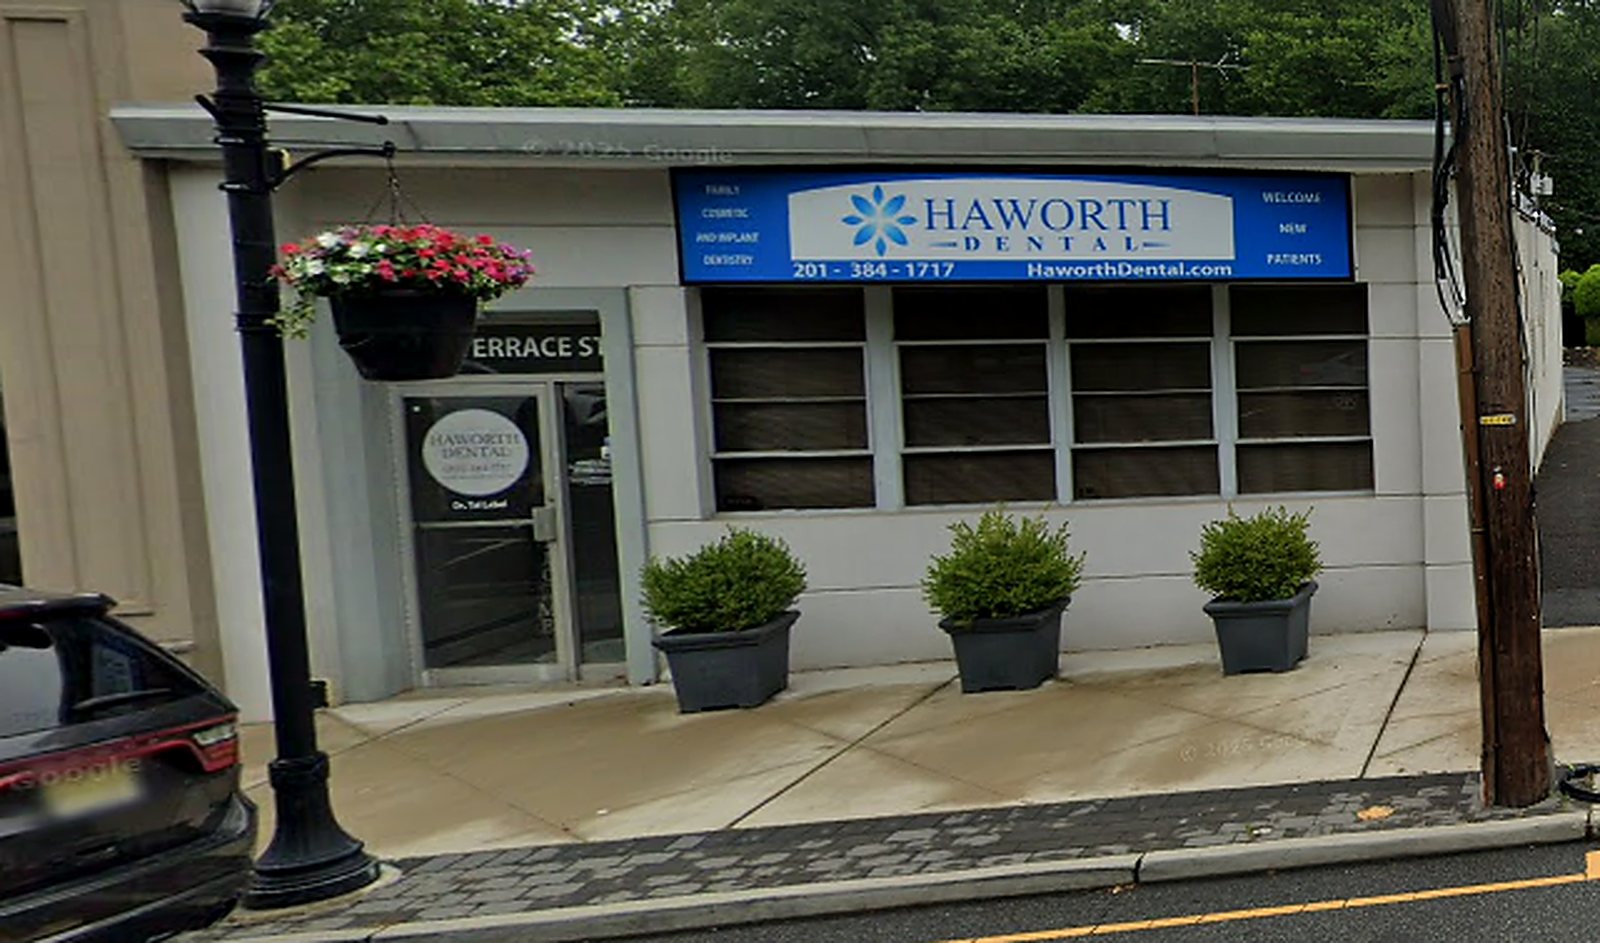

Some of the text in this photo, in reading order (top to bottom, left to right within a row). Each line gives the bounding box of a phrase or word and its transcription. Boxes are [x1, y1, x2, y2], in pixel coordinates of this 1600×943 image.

[705, 184, 741, 195] FAMILY
[1262, 191, 1321, 203] WELCOME
[701, 207, 750, 219] COSMETIC
[924, 198, 1171, 232] HAWORTH
[1279, 222, 1308, 234] NEW
[696, 231, 760, 244] AND IMPLANT
[964, 236, 1139, 251] DENTAL
[703, 254, 754, 266] DENTISTRY
[1266, 253, 1323, 265] PATIENTS
[793, 262, 828, 278] 201
[850, 262, 887, 278] 384
[905, 262, 955, 278] 1717
[1027, 262, 1233, 277] HaworthDental.com
[472, 337, 572, 358] ERRACE
[430, 432, 521, 447] HAWORTH
[441, 446, 512, 460] DENTAL
